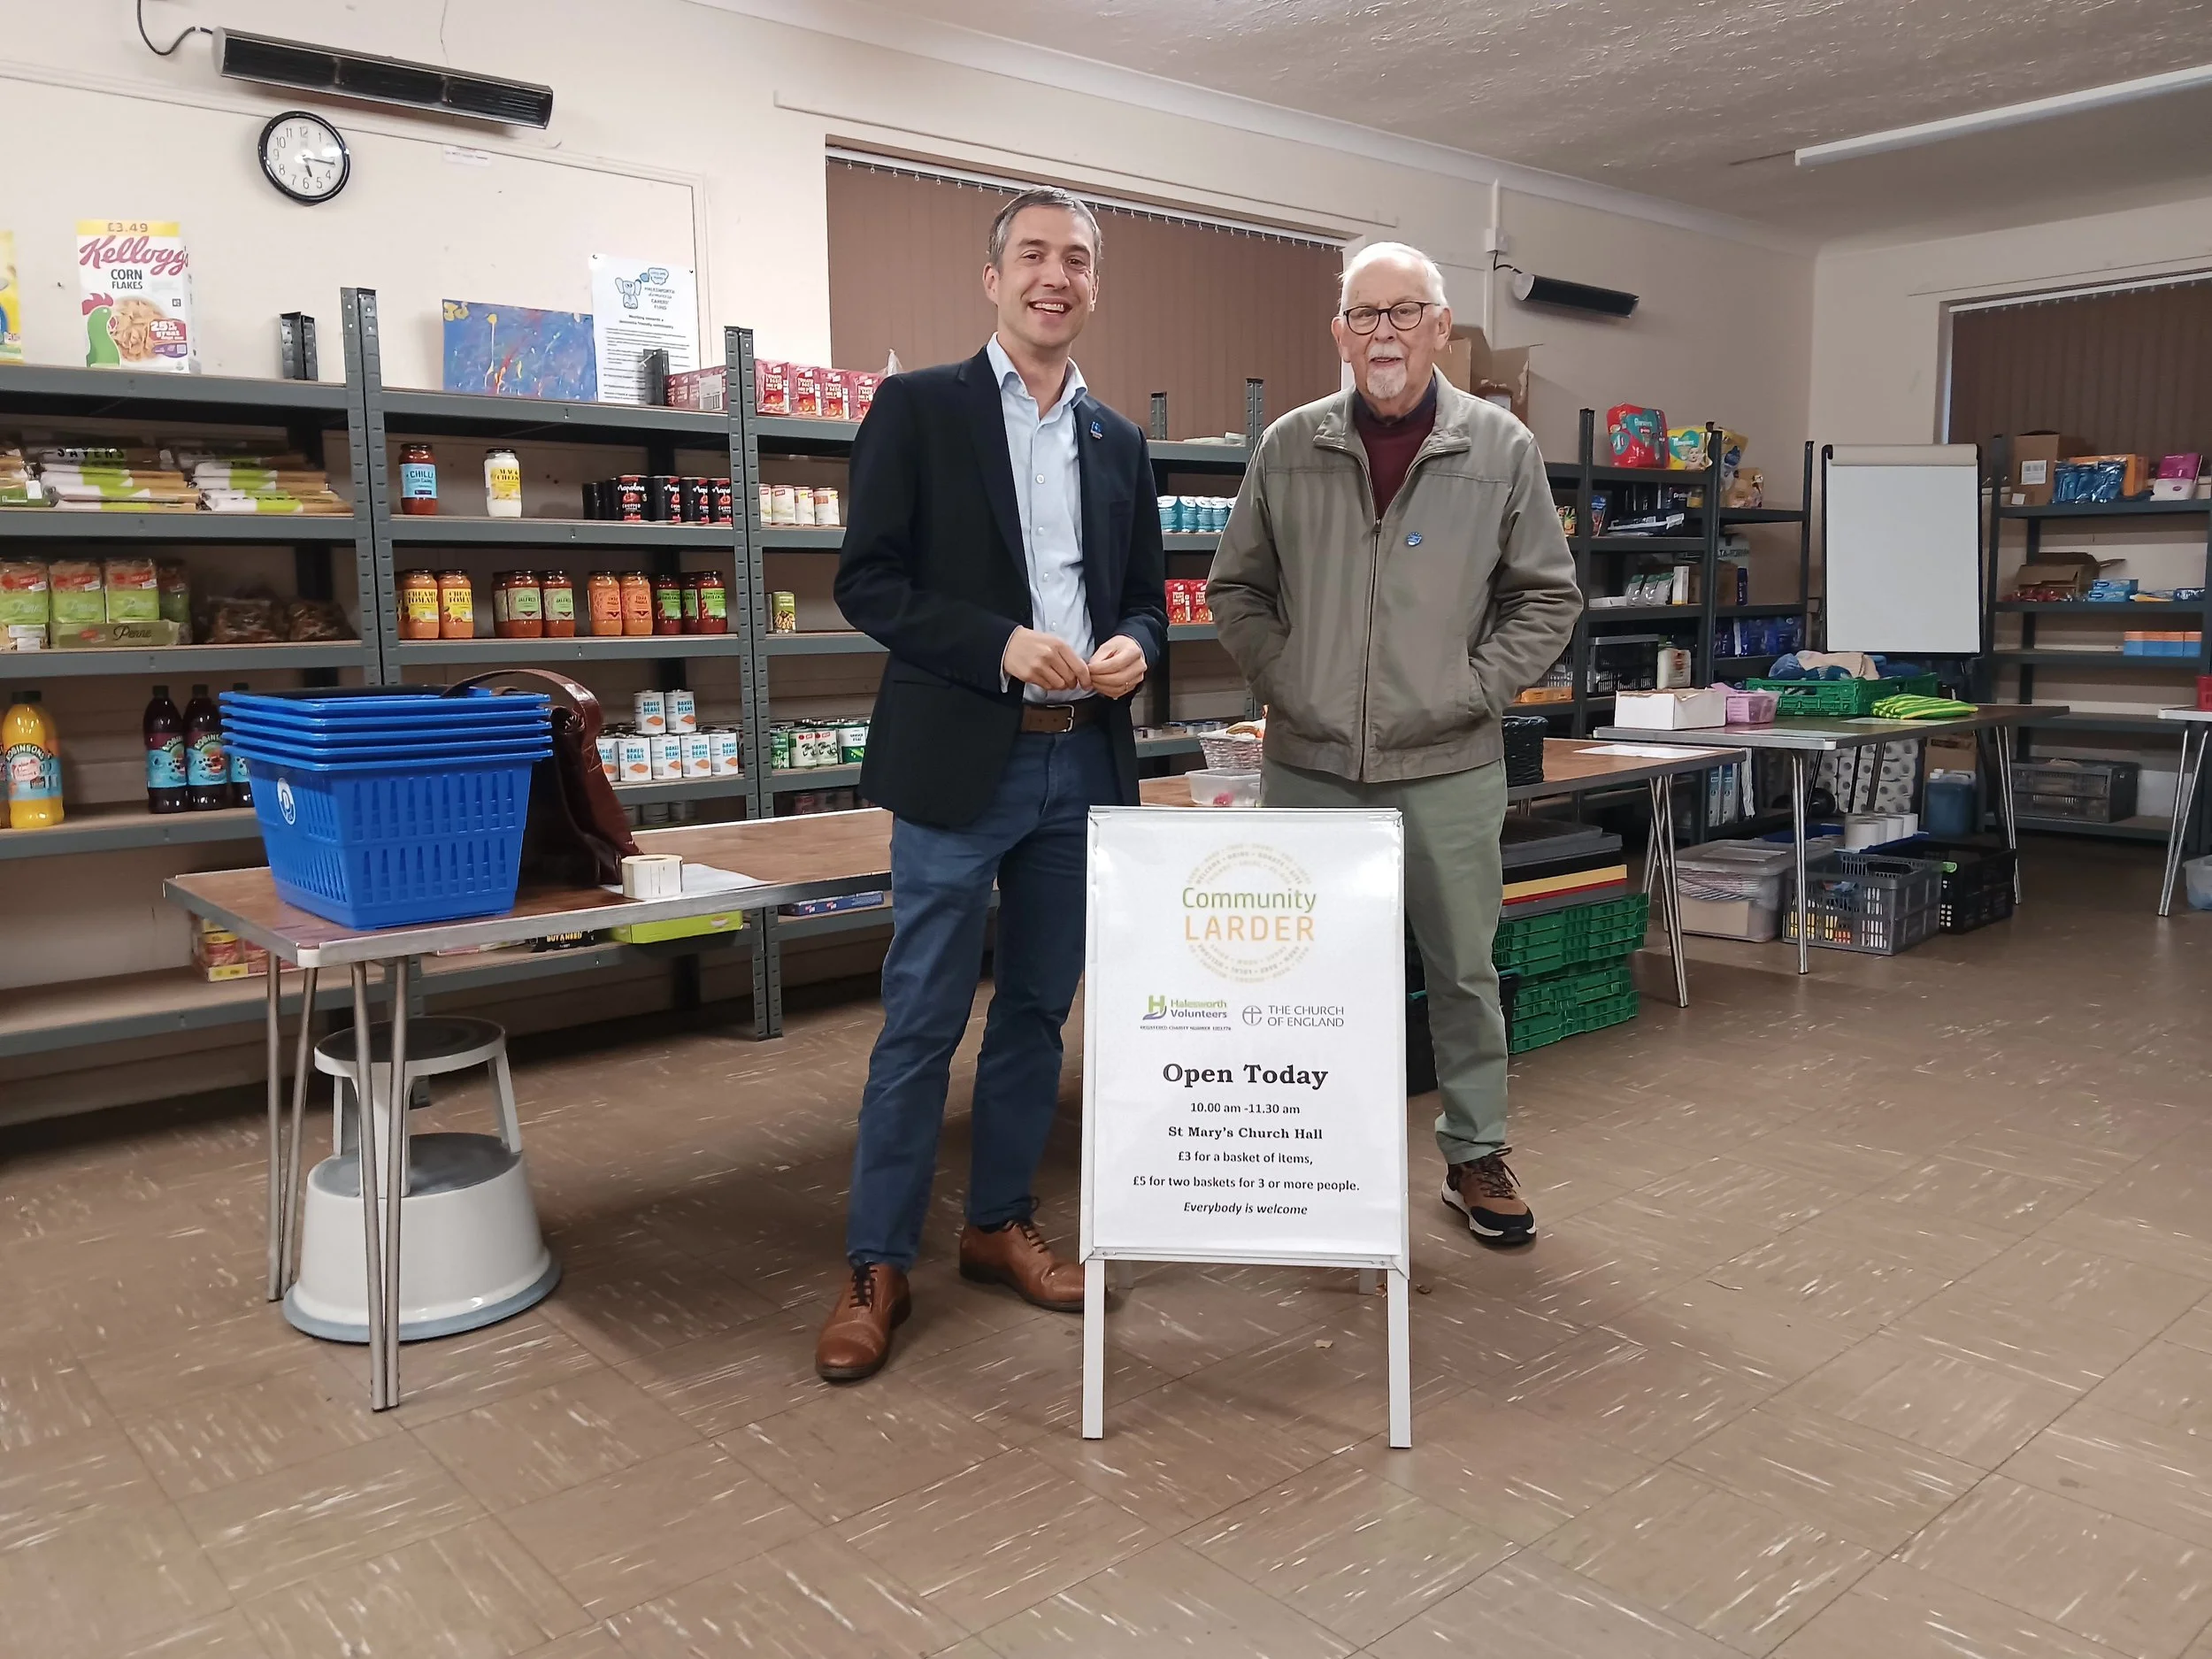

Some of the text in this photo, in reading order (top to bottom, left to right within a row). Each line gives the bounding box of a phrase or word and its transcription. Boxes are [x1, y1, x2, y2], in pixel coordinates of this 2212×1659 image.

[286, 127, 293, 138] 11
[299, 127, 308, 137] 12
[319, 133, 321, 142] 1
[276, 136, 286, 149] 10
[273, 148, 280, 160] 9
[280, 164, 286, 175] 8
[326, 170, 332, 180] 4
[291, 174, 296, 186] 7
[303, 177, 310, 189] 6
[316, 177, 323, 188] 5
[107, 222, 149, 233] £3.49
[111, 269, 142, 280] CORN
[111, 281, 143, 290] FLAKES
[113, 624, 152, 639] Penne
[1182, 887, 1317, 913] Community
[1185, 915, 1315, 941] LARDER
[1171, 999, 1227, 1009] Halesworth
[1171, 1010, 1227, 1018] Volunteers
[1269, 1005, 1344, 1015] THE CHURCH
[1268, 1018, 1344, 1027] OF ENGLAND
[1163, 1064, 1328, 1090] Open Today
[1191, 1102, 1220, 1112] 10.00
[1244, 1104, 1279, 1113] -11.30
[1169, 1126, 1183, 1137] St
[1239, 1127, 1289, 1139] Church
[1294, 1129, 1322, 1139] Hall
[1179, 1151, 1191, 1161] £3
[1194, 1151, 1210, 1161] for
[1224, 1151, 1260, 1163] basket
[1263, 1153, 1275, 1163] of
[1279, 1153, 1312, 1165] items,
[1133, 1176, 1146, 1186] £5
[1149, 1175, 1165, 1186] for
[1169, 1178, 1190, 1187] two
[1194, 1176, 1235, 1187] baskets
[1239, 1178, 1255, 1187] for
[1258, 1179, 1264, 1188] 3
[1317, 1180, 1359, 1193] people.
[1184, 1202, 1307, 1215] Everybody is welcome
